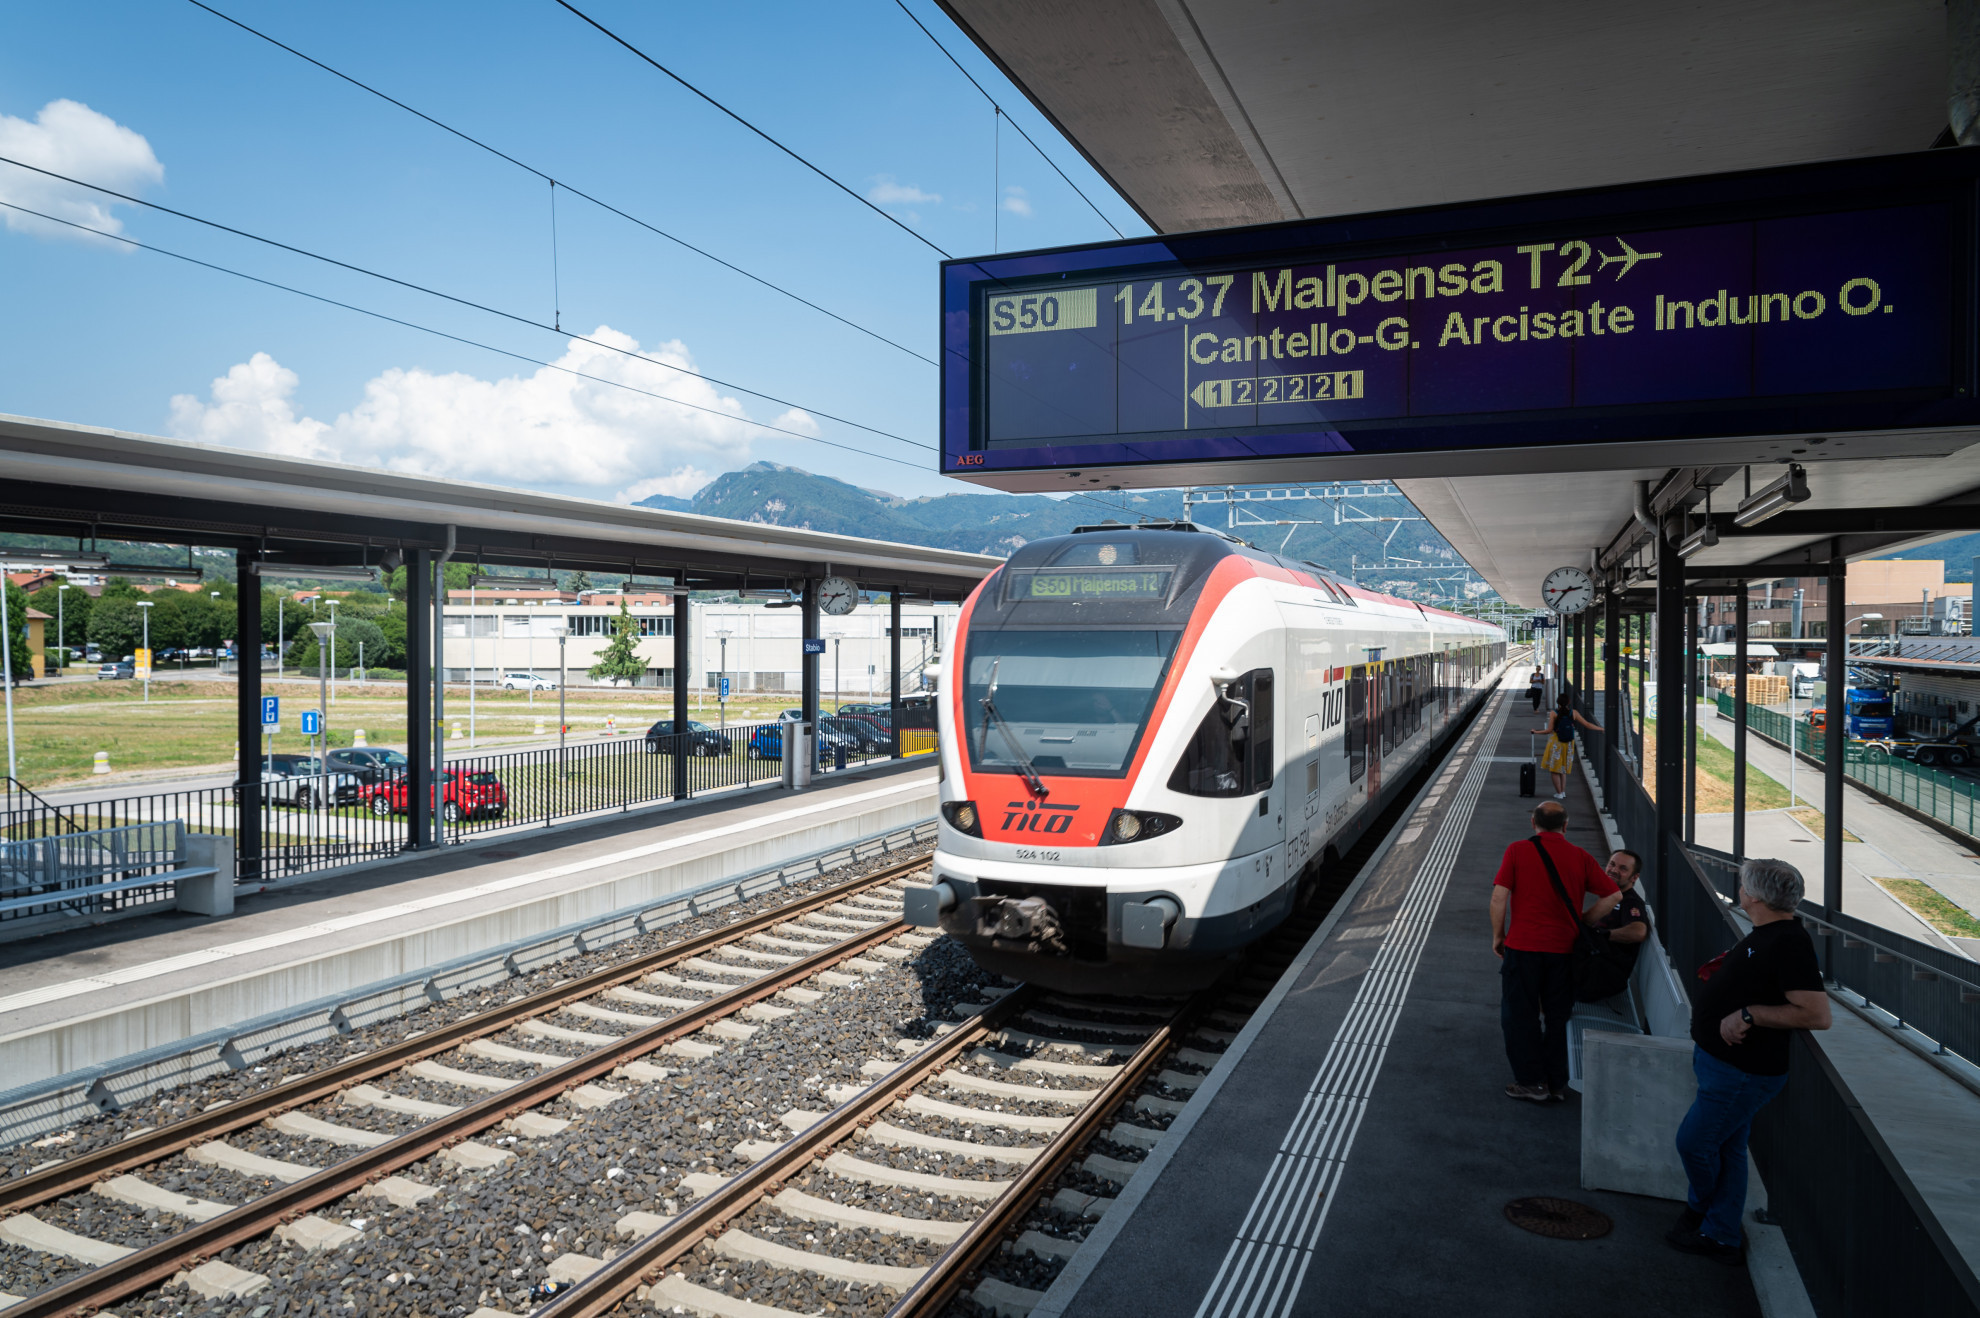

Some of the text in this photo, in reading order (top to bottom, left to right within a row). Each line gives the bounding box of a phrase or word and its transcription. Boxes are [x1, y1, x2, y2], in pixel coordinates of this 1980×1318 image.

[993, 240, 1592, 331] S50 14.37 Malpensa T2
[1190, 277, 1894, 364] Cantello-G. Arcisate Induno O.
[956, 454, 984, 466] AEG
[1036, 572, 1158, 596] S50 Malpensa T2
[805, 643, 821, 652] Stabio
[266, 699, 275, 712] P
[1322, 687, 1343, 731] TILO
[1000, 811, 1074, 834] TILO
[1016, 849, 1061, 862] 524 102
